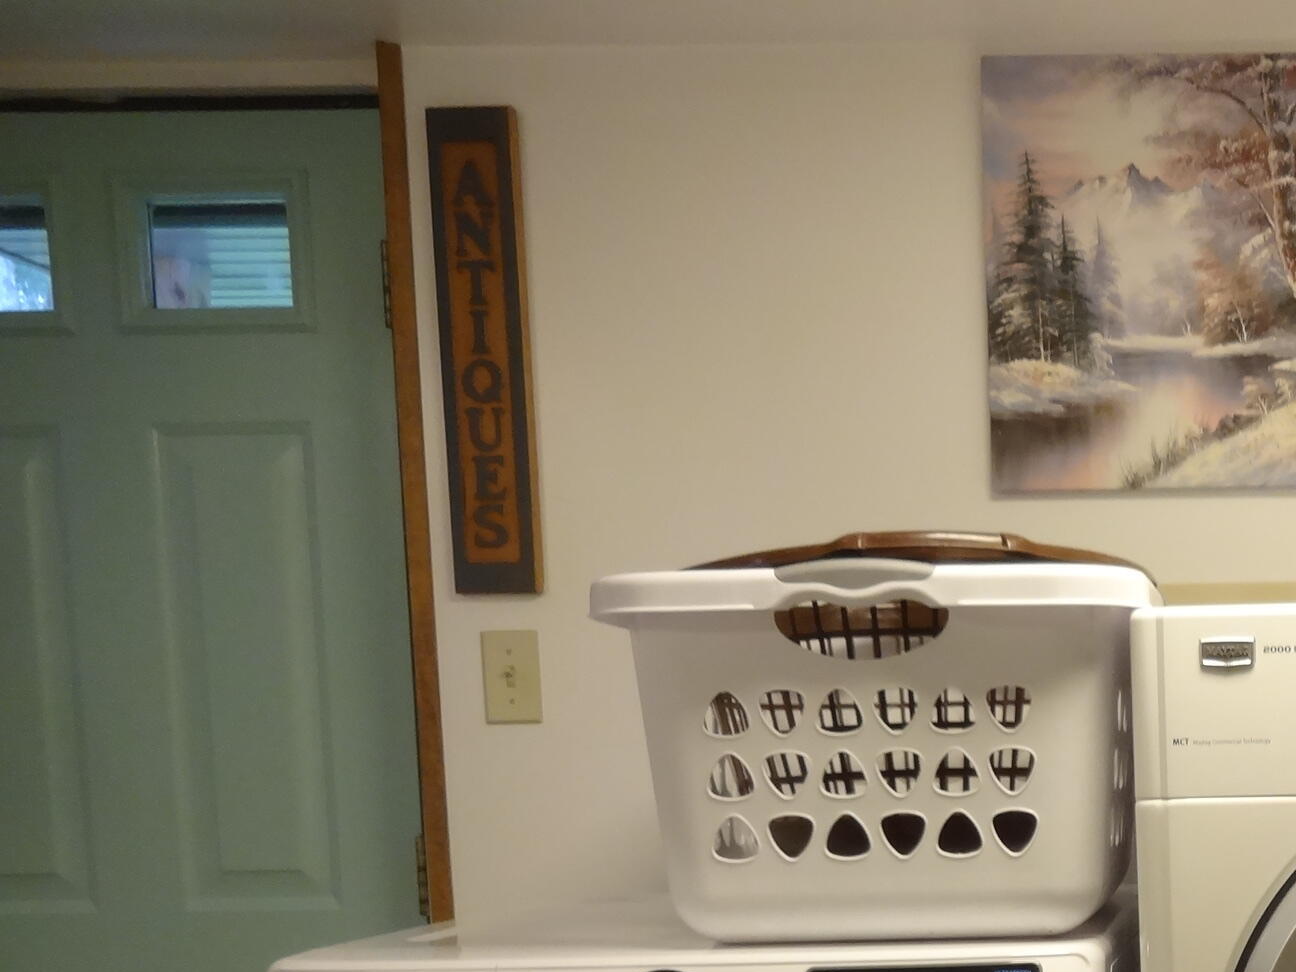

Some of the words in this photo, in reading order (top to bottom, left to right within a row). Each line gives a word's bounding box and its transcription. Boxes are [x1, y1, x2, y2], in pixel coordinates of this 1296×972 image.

[453, 159, 509, 550] ANTIQUES
[1263, 645, 1291, 654] 2000
[1172, 738, 1189, 746] MCT
